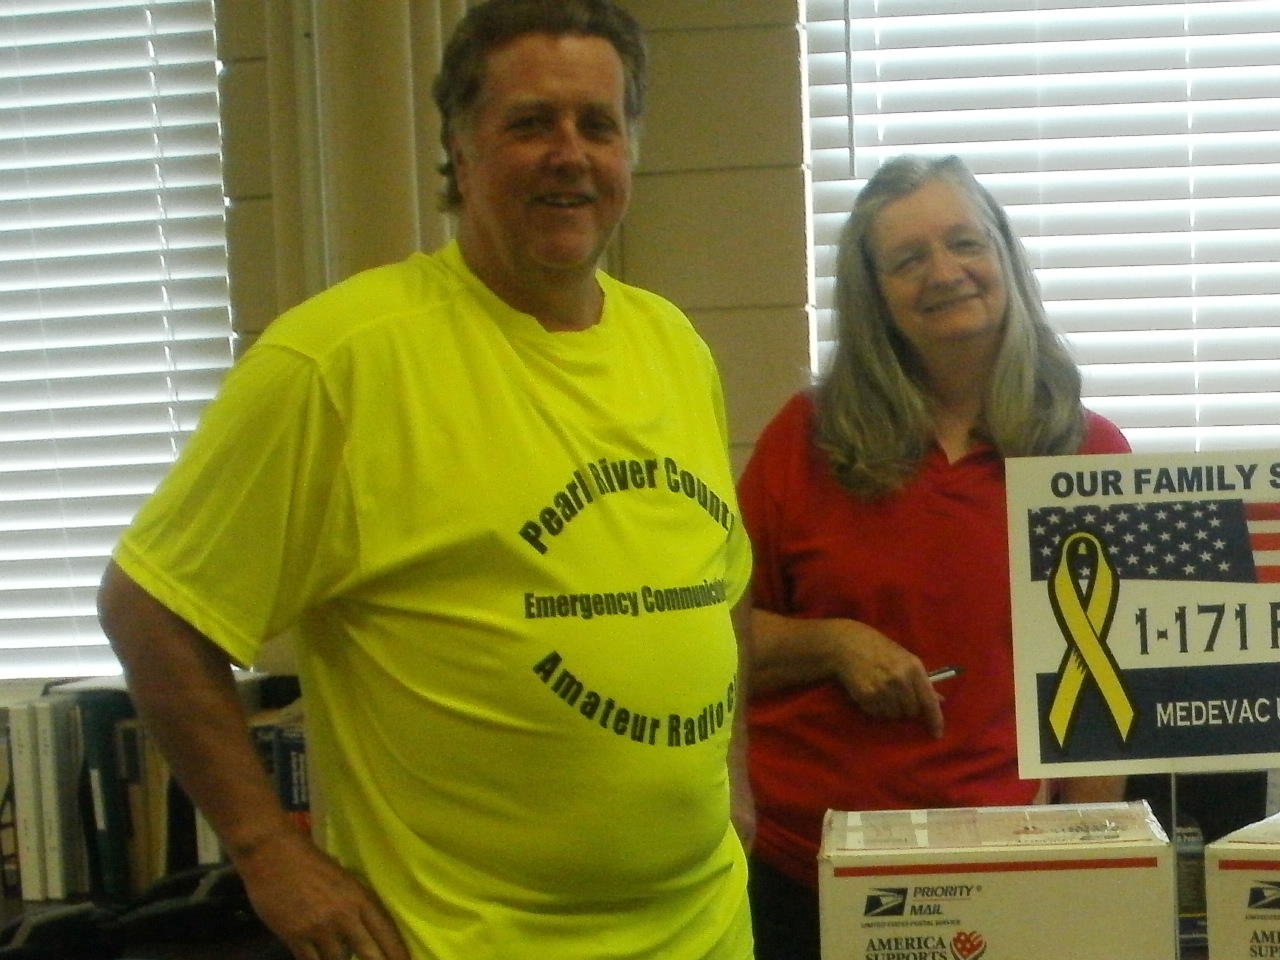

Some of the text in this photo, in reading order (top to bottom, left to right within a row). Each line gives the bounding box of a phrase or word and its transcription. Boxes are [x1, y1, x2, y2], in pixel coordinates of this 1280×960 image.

[1051, 470, 1121, 497] OUR
[1134, 463, 1258, 494] FAMILY
[519, 470, 593, 554] Pearl
[588, 458, 658, 495] River
[524, 591, 639, 619] Emergency
[1135, 602, 1249, 655] 1-171
[532, 650, 660, 746] Amateur
[668, 701, 724, 747] Radio
[1156, 698, 1271, 727] MEDEVAC
[913, 885, 974, 898] PRIORITY
[910, 904, 943, 915] MAIL
[866, 936, 946, 952] AMERICA
